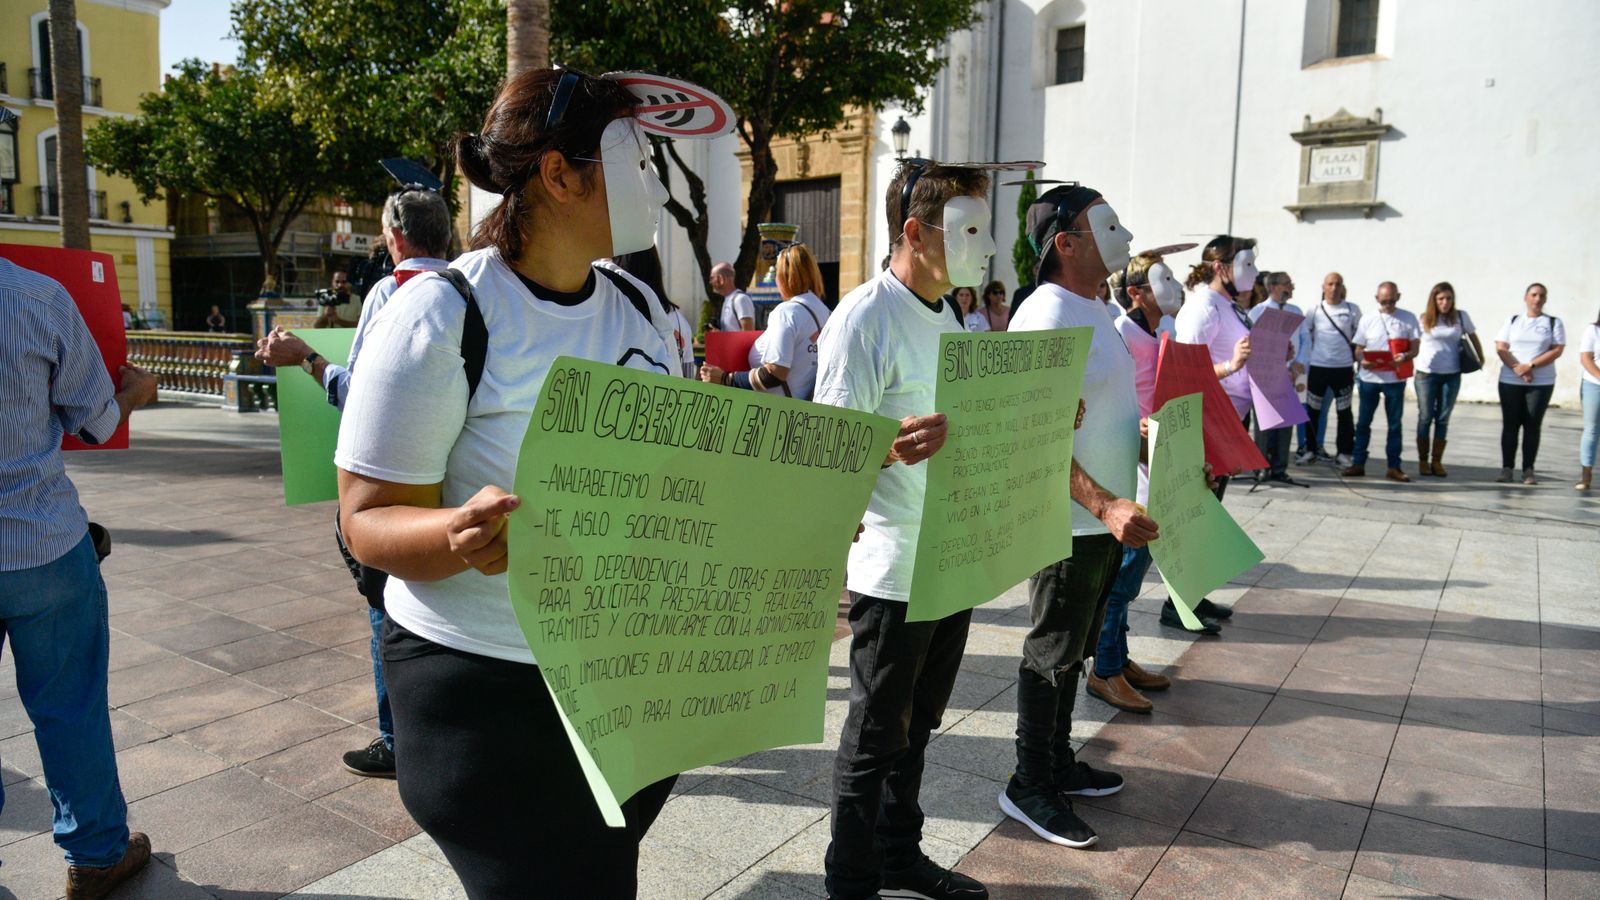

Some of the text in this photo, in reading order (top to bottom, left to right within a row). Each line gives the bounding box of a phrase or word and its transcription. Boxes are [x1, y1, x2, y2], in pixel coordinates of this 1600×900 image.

[1319, 153, 1357, 164] PLAZA
[1323, 166, 1352, 176] ALTA
[541, 368, 874, 473] SIN COBERTURA EN DIGITALIDAD
[660, 475, 706, 506] DIGITAL
[570, 508, 610, 537] AISLO
[624, 512, 719, 548] SOCIALMENTE
[947, 507, 968, 523] VIVO
[970, 504, 980, 518] EN
[594, 554, 688, 586] DEPENDENCIA
[701, 562, 722, 587] DE
[728, 566, 768, 592] OTRAS
[773, 568, 832, 590] ENTIDADES
[538, 586, 571, 614] PARA
[584, 582, 650, 612] SOLICITAR
[763, 591, 816, 613] REALIZAR
[538, 613, 600, 643] TRÁMITES
[608, 612, 620, 636] Y
[624, 612, 712, 638] COMUNICARME
[714, 614, 738, 636] CON
[738, 617, 750, 637] LA
[580, 652, 650, 685] LIMITACIONES
[656, 650, 674, 674] EN
[677, 650, 694, 673] LA
[758, 644, 772, 667] DE
[775, 640, 816, 664] EMPLEO
[642, 698, 672, 723] PARA
[680, 690, 754, 718] COMUNICARME
[760, 682, 780, 704] CON
[784, 678, 797, 698] LA
